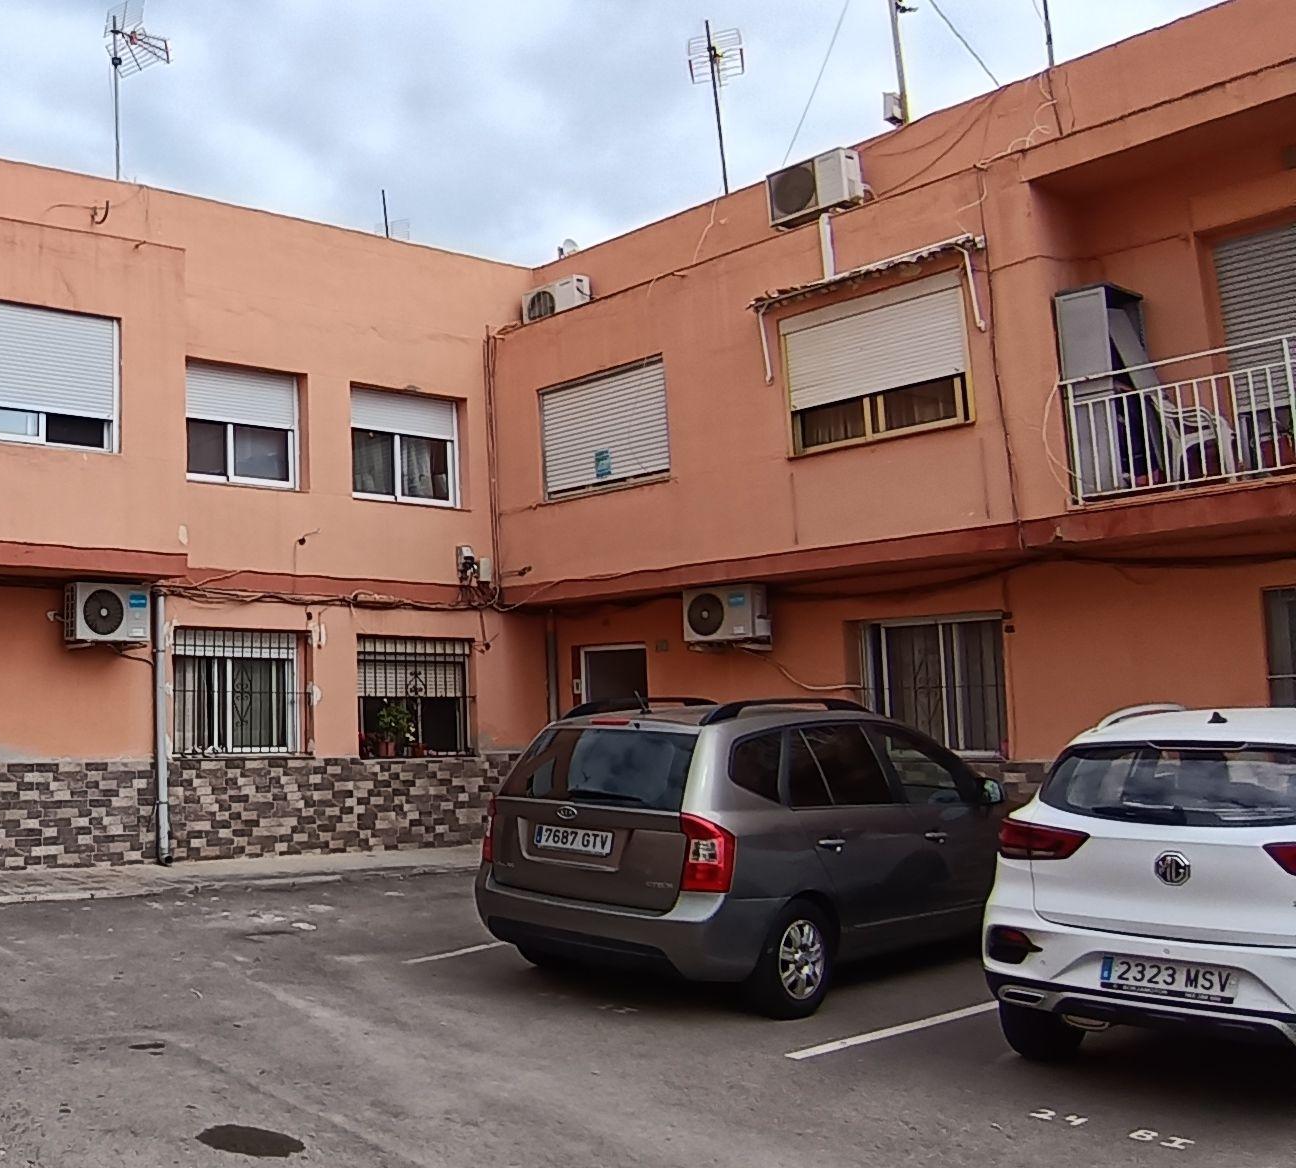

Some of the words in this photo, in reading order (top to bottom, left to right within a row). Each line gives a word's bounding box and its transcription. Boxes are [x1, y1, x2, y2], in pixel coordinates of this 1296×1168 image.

[545, 828, 578, 846] 7687
[582, 833, 608, 850] GTV
[1158, 855, 1186, 882] MG
[1117, 961, 1176, 986] 2323
[1184, 968, 1231, 992] MSV
[1029, 1108, 1088, 1126] 24
